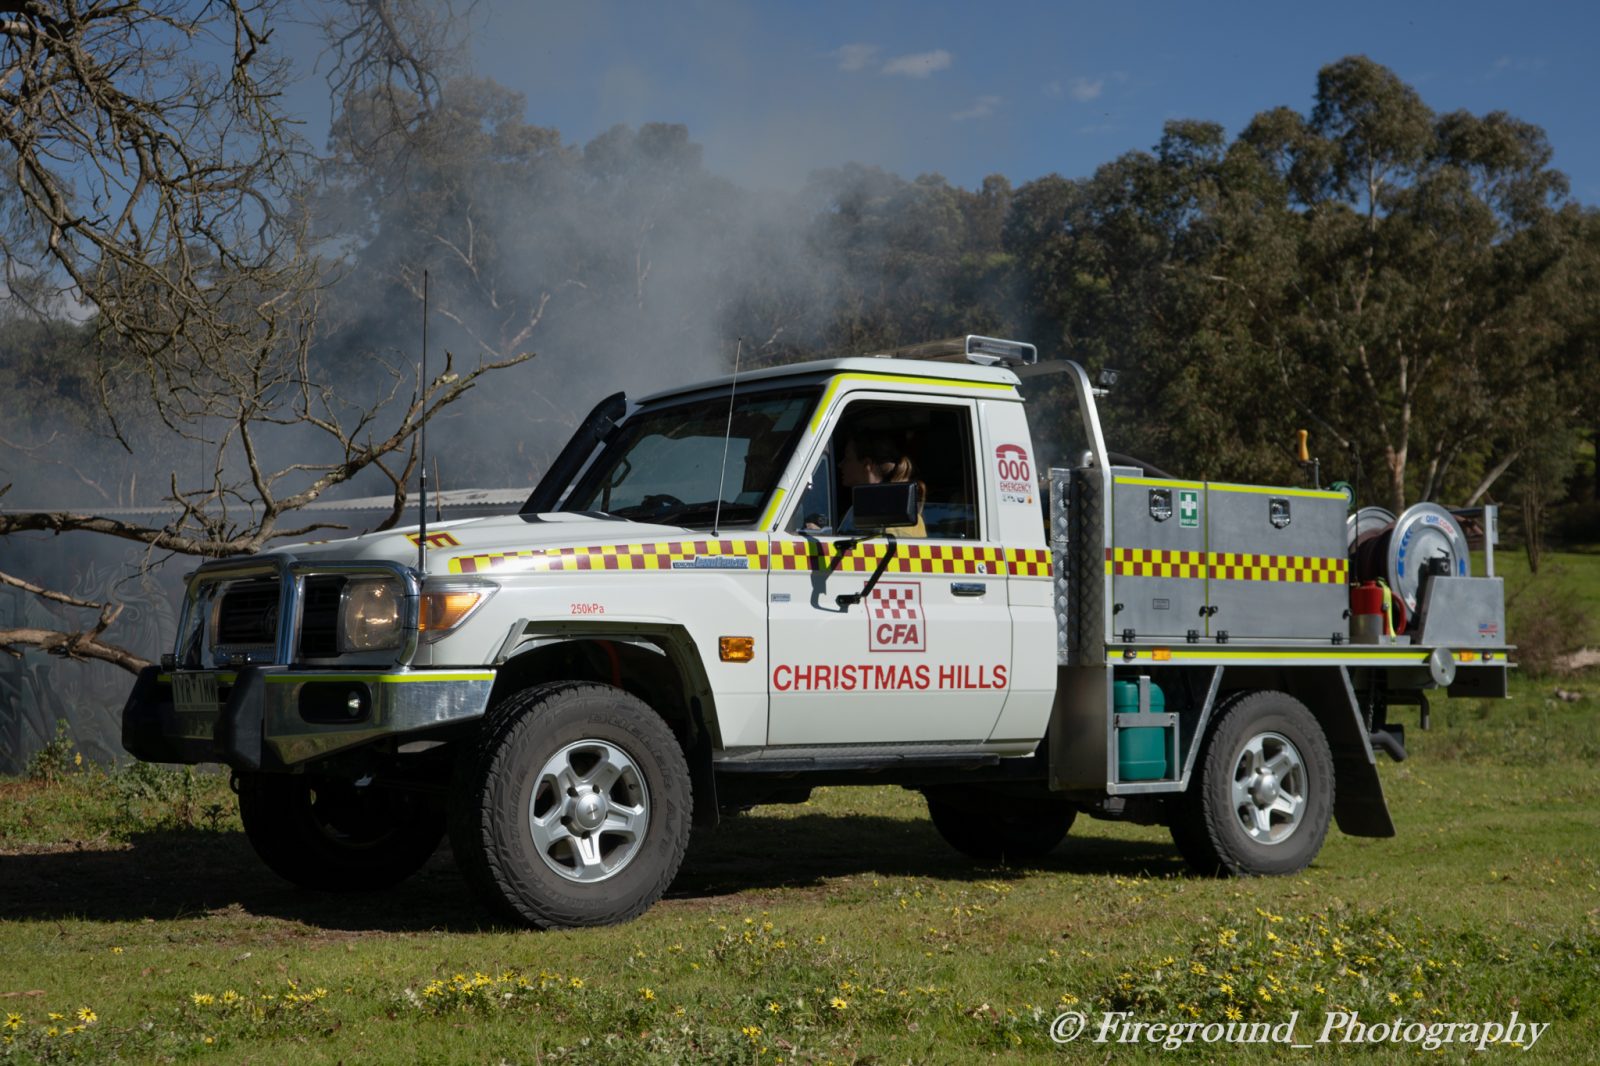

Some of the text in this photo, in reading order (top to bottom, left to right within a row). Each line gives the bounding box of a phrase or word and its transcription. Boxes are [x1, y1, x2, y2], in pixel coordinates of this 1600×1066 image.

[998, 459, 1030, 481] 000
[999, 481, 1032, 493] EMERGENCY
[571, 603, 605, 615] 250kPa
[876, 623, 919, 645] CFA
[773, 664, 1008, 691] CHRISTMAS HILLS
